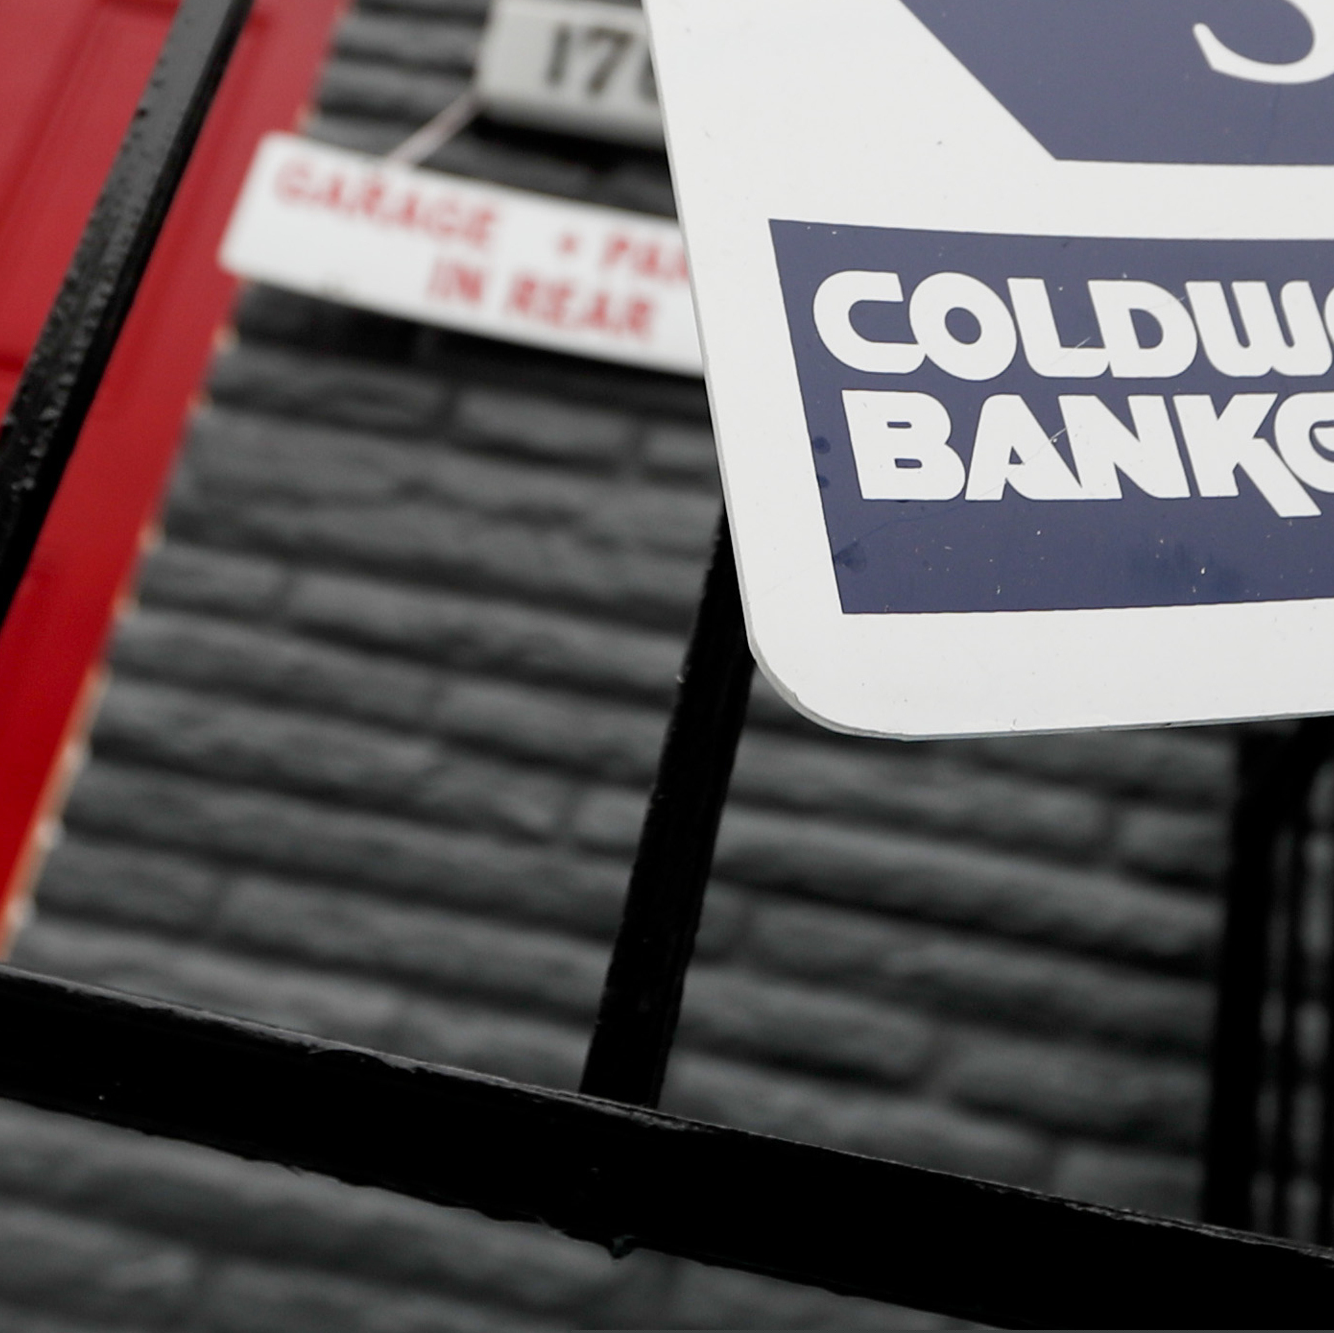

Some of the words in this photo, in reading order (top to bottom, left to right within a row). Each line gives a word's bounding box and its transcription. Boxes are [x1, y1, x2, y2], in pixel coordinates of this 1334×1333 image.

[274, 158, 502, 251] GARAGE
[428, 259, 485, 309] IN
[506, 269, 660, 342] REAR
